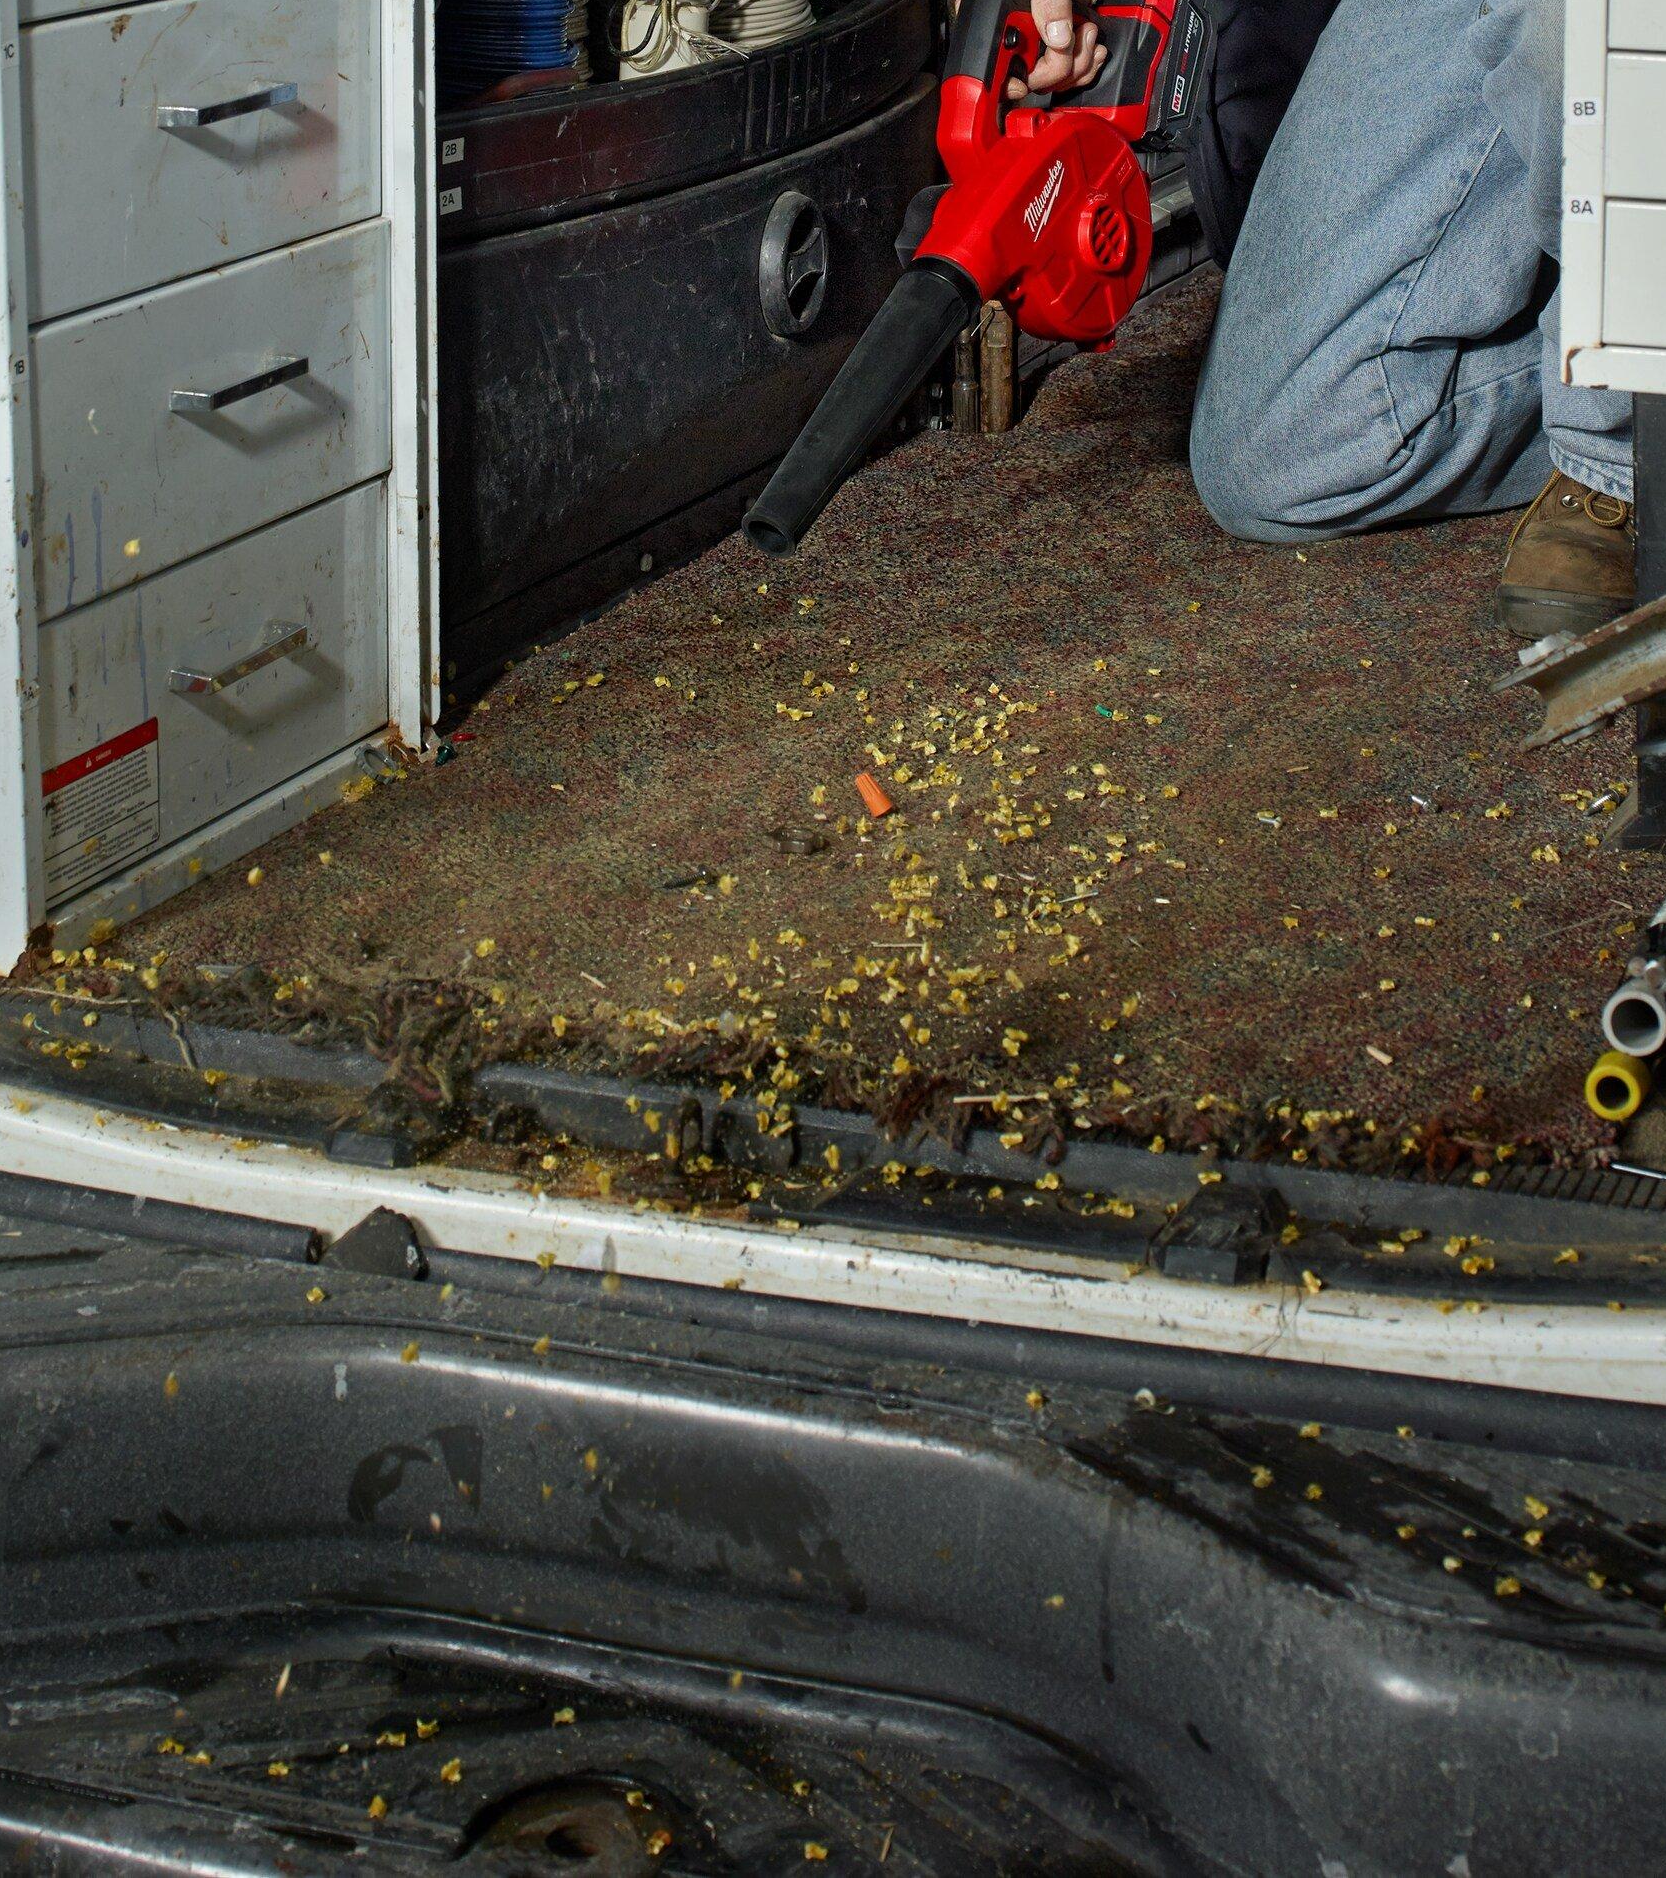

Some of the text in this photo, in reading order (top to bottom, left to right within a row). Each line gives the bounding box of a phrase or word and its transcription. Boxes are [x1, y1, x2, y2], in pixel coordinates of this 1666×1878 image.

[3, 42, 15, 60] 1C
[1173, 77, 1185, 111] M18
[1574, 101, 1596, 116] 8B
[445, 143, 457, 157] 2B
[442, 193, 455, 207] 2A
[1023, 159, 1063, 233] Milwaukee
[1571, 199, 1594, 215] 8A
[14, 360, 25, 376] 1B
